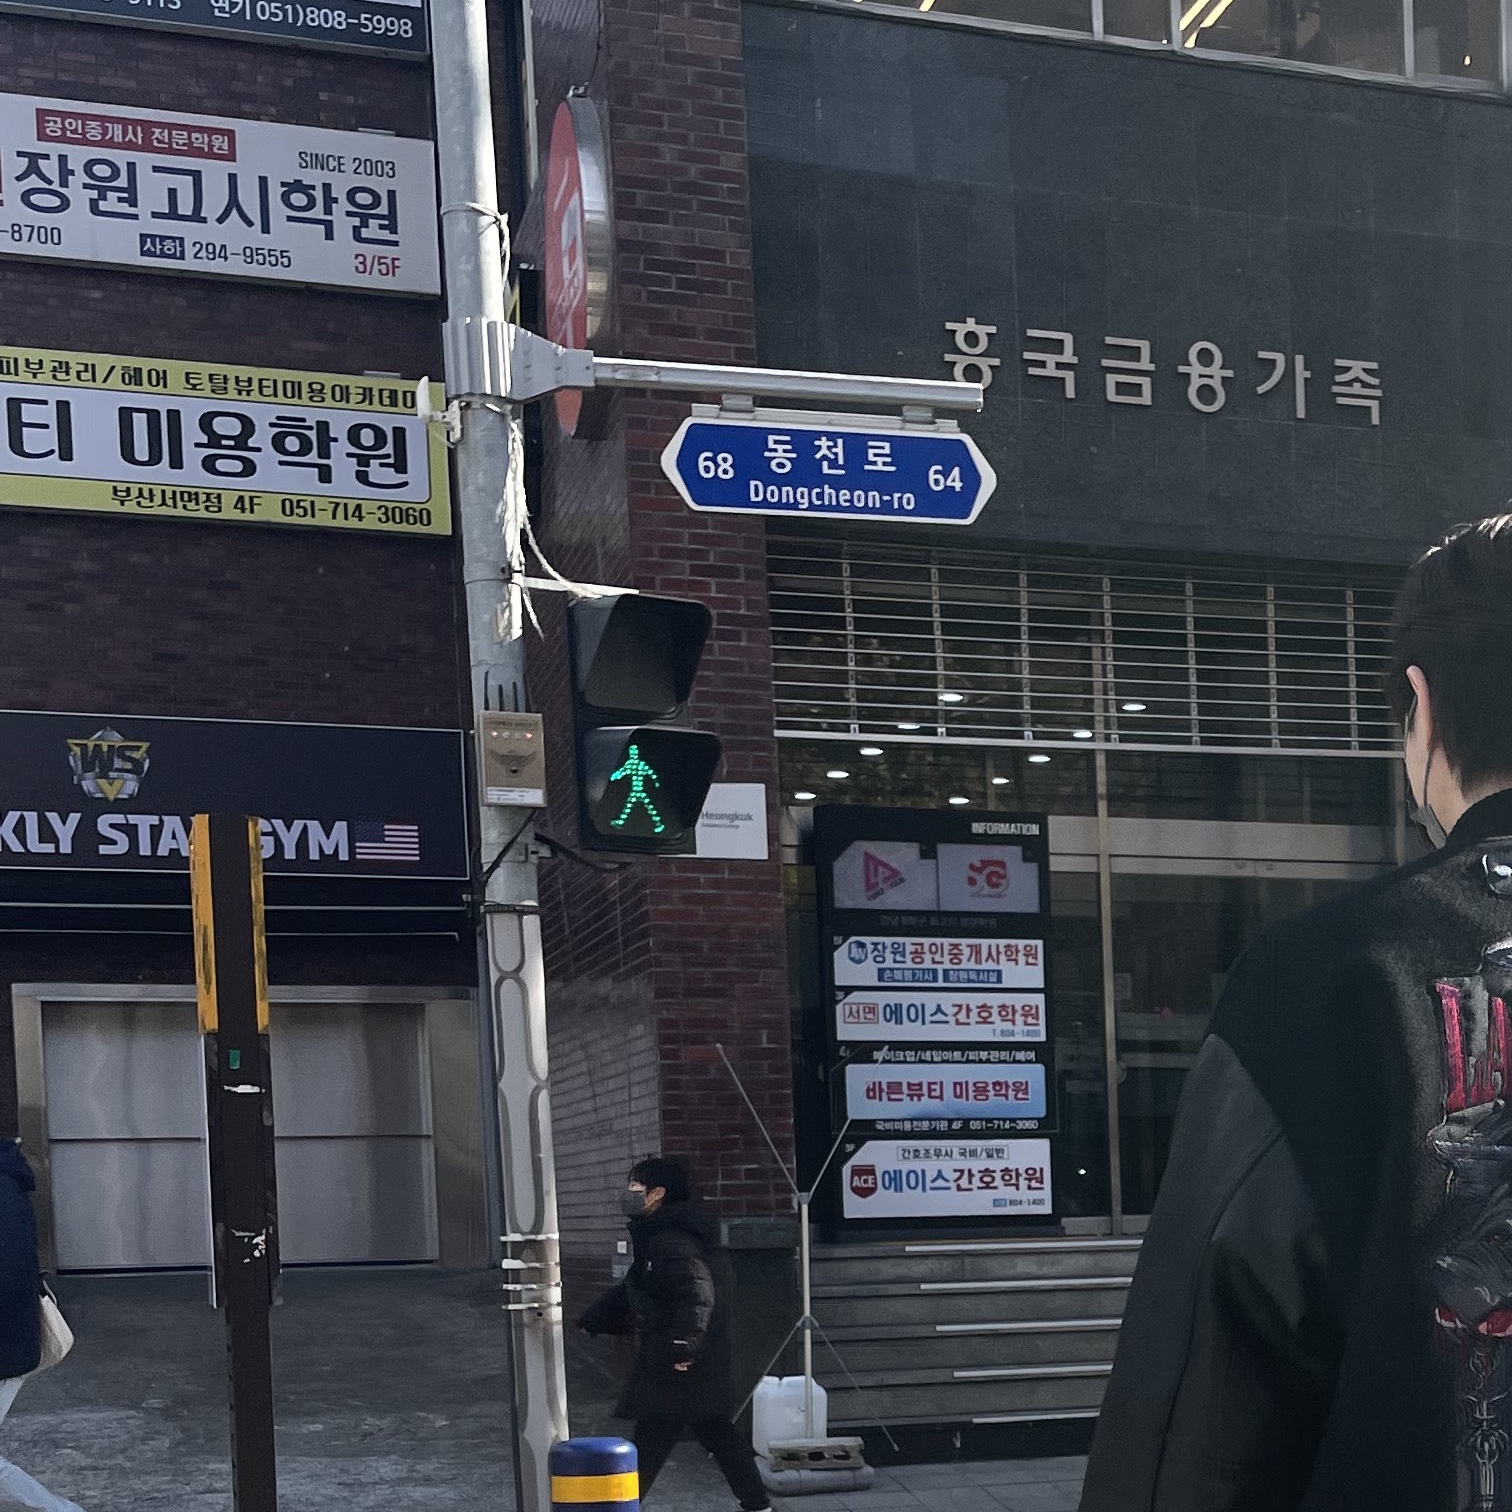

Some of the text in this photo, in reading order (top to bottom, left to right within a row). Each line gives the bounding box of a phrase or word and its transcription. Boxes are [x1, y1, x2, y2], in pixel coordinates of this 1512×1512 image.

[256, 4, 413, 39] 051)808-5998
[43, 115, 230, 155] 공인중개사 전문학원
[299, 151, 397, 179] SINCE 2003
[14, 150, 400, 248] 장원고시학원
[142, 236, 183, 259] 사하
[192, 241, 292, 269] 294-9555
[354, 253, 401, 278] 3/5F
[118, 406, 411, 490] 미용학원
[697, 451, 735, 480] 68
[927, 465, 964, 493] 64
[112, 485, 433, 527] 부산서면점 4F 051-714-3060
[749, 480, 916, 511] Dongcheon-ro
[0, 810, 82, 854] KLY
[97, 813, 192, 857] STA
[971, 822, 1040, 836] INFORMATION
[846, 1003, 1041, 1027] 서면 에이스간호학원
[865, 1080, 1030, 1102] 바른뷰티 미용학원
[852, 1166, 1045, 1194] ACE 에이스간호학원
